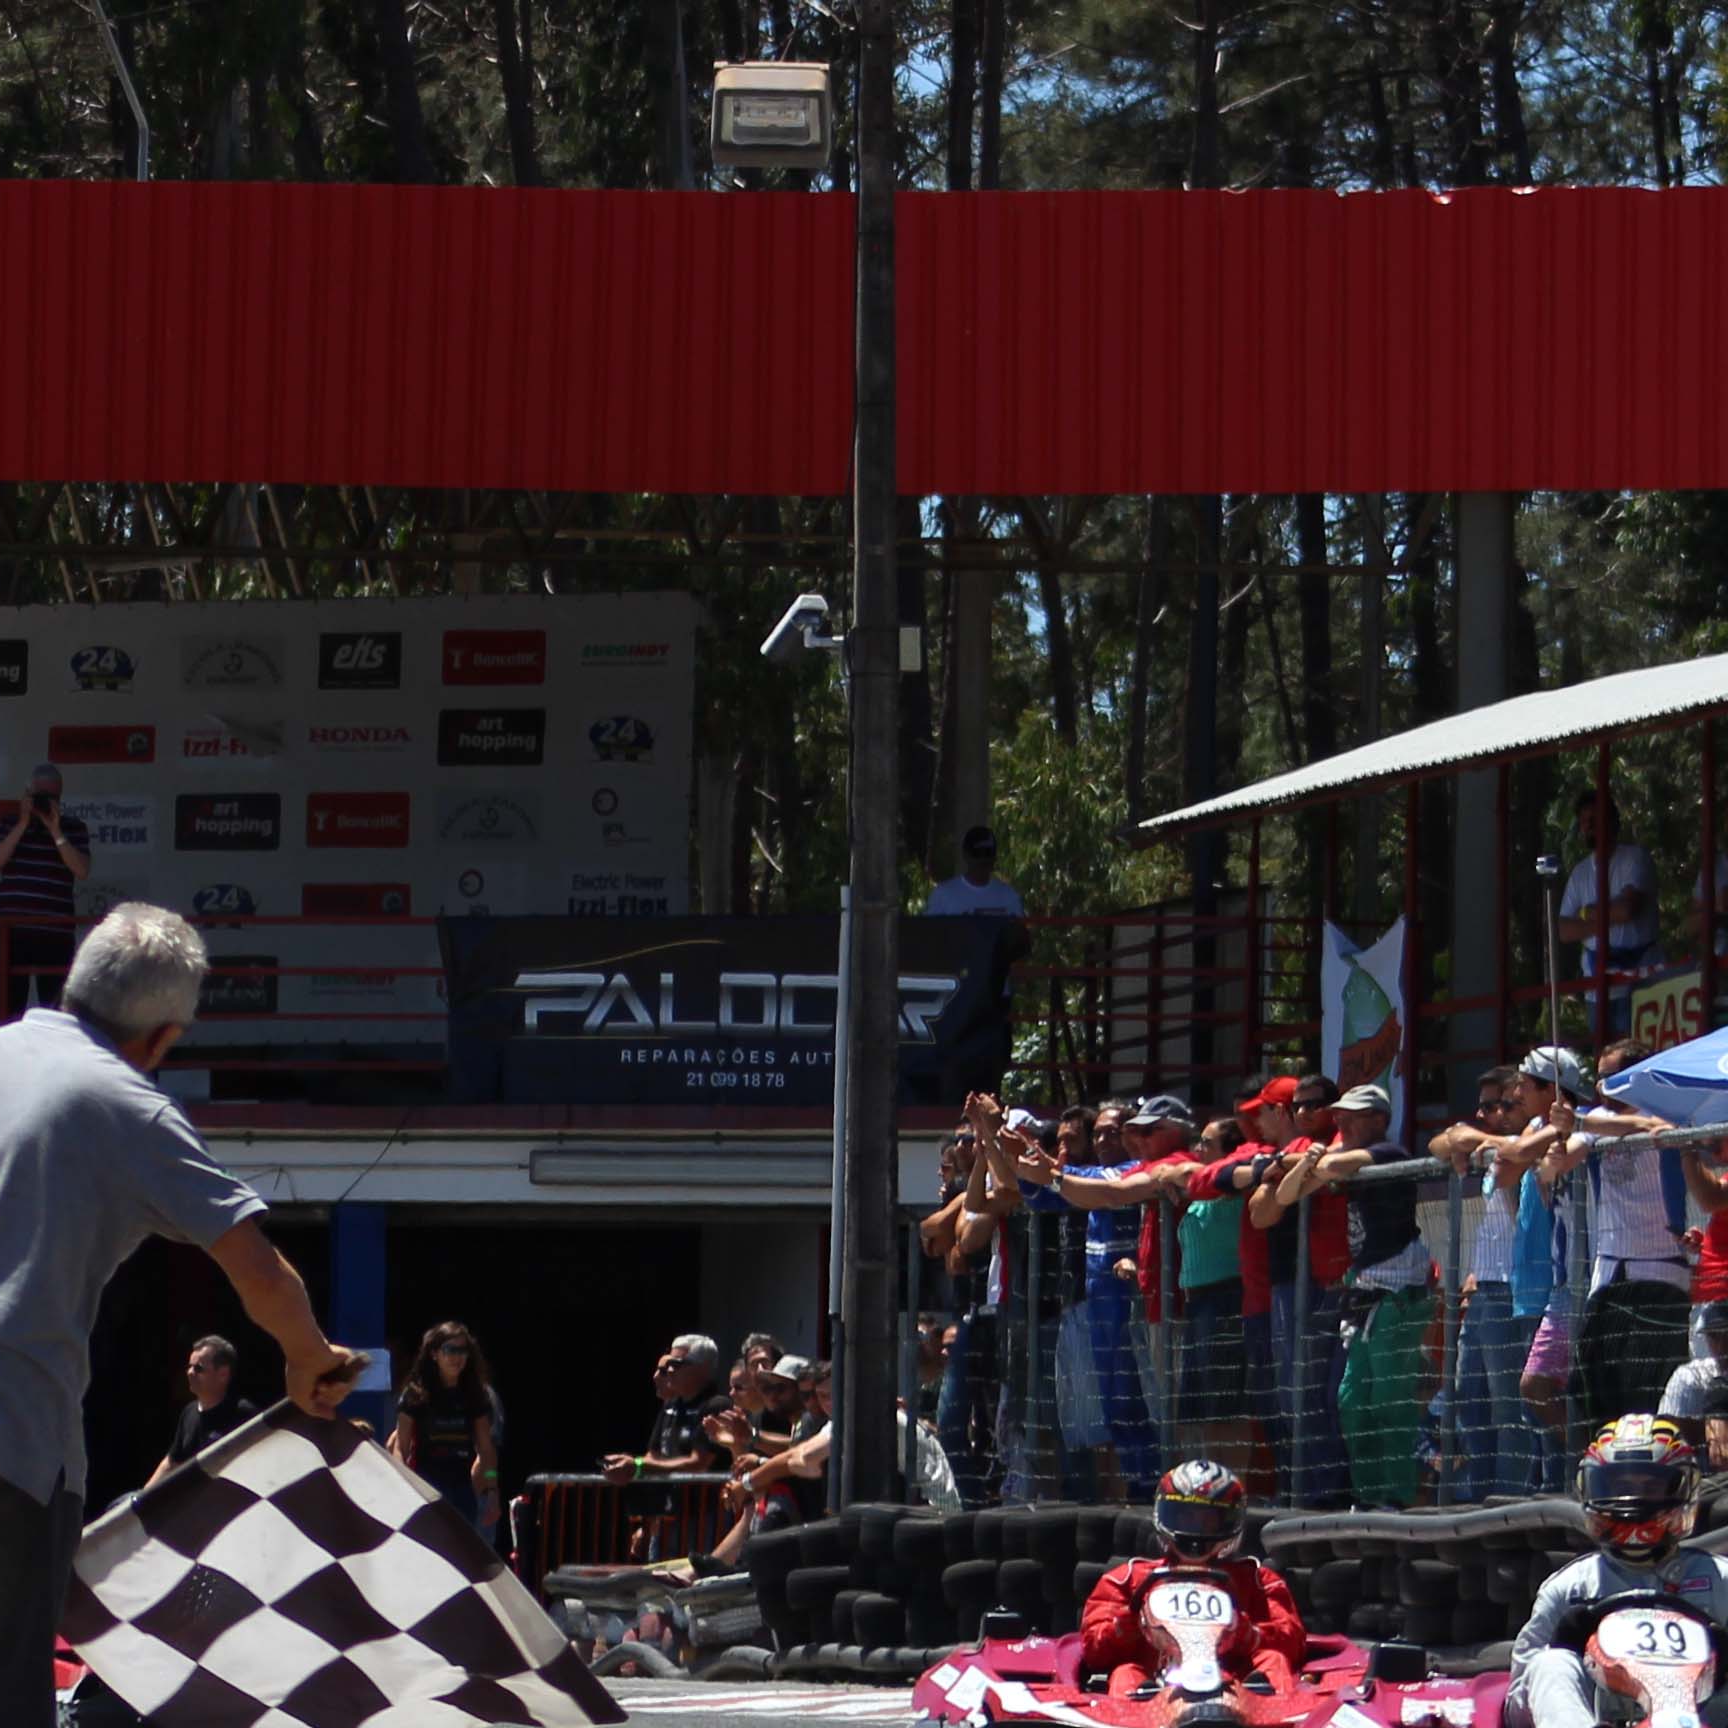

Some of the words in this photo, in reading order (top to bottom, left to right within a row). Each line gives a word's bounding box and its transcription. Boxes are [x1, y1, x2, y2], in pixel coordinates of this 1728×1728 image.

[79, 649, 117, 672] 24
[475, 716, 504, 732] art
[598, 720, 638, 740] 24
[308, 727, 413, 744] HONDA
[457, 732, 537, 752] hopping
[104, 801, 145, 818] Power
[211, 801, 241, 817] art
[90, 825, 148, 844] -Flex
[194, 816, 274, 836] hopping
[571, 873, 621, 891] Electric
[624, 873, 666, 891] Power
[200, 886, 240, 911] 24
[513, 971, 961, 1038] PALOCR
[620, 1048, 776, 1068] REPARAÇÕES
[789, 1051, 834, 1066] AUT
[686, 1072, 703, 1087] 21
[742, 1073, 761, 1088] 18
[765, 1073, 785, 1088] 78
[1169, 1590, 1223, 1619] 160
[1636, 1621, 1687, 1653] 39
